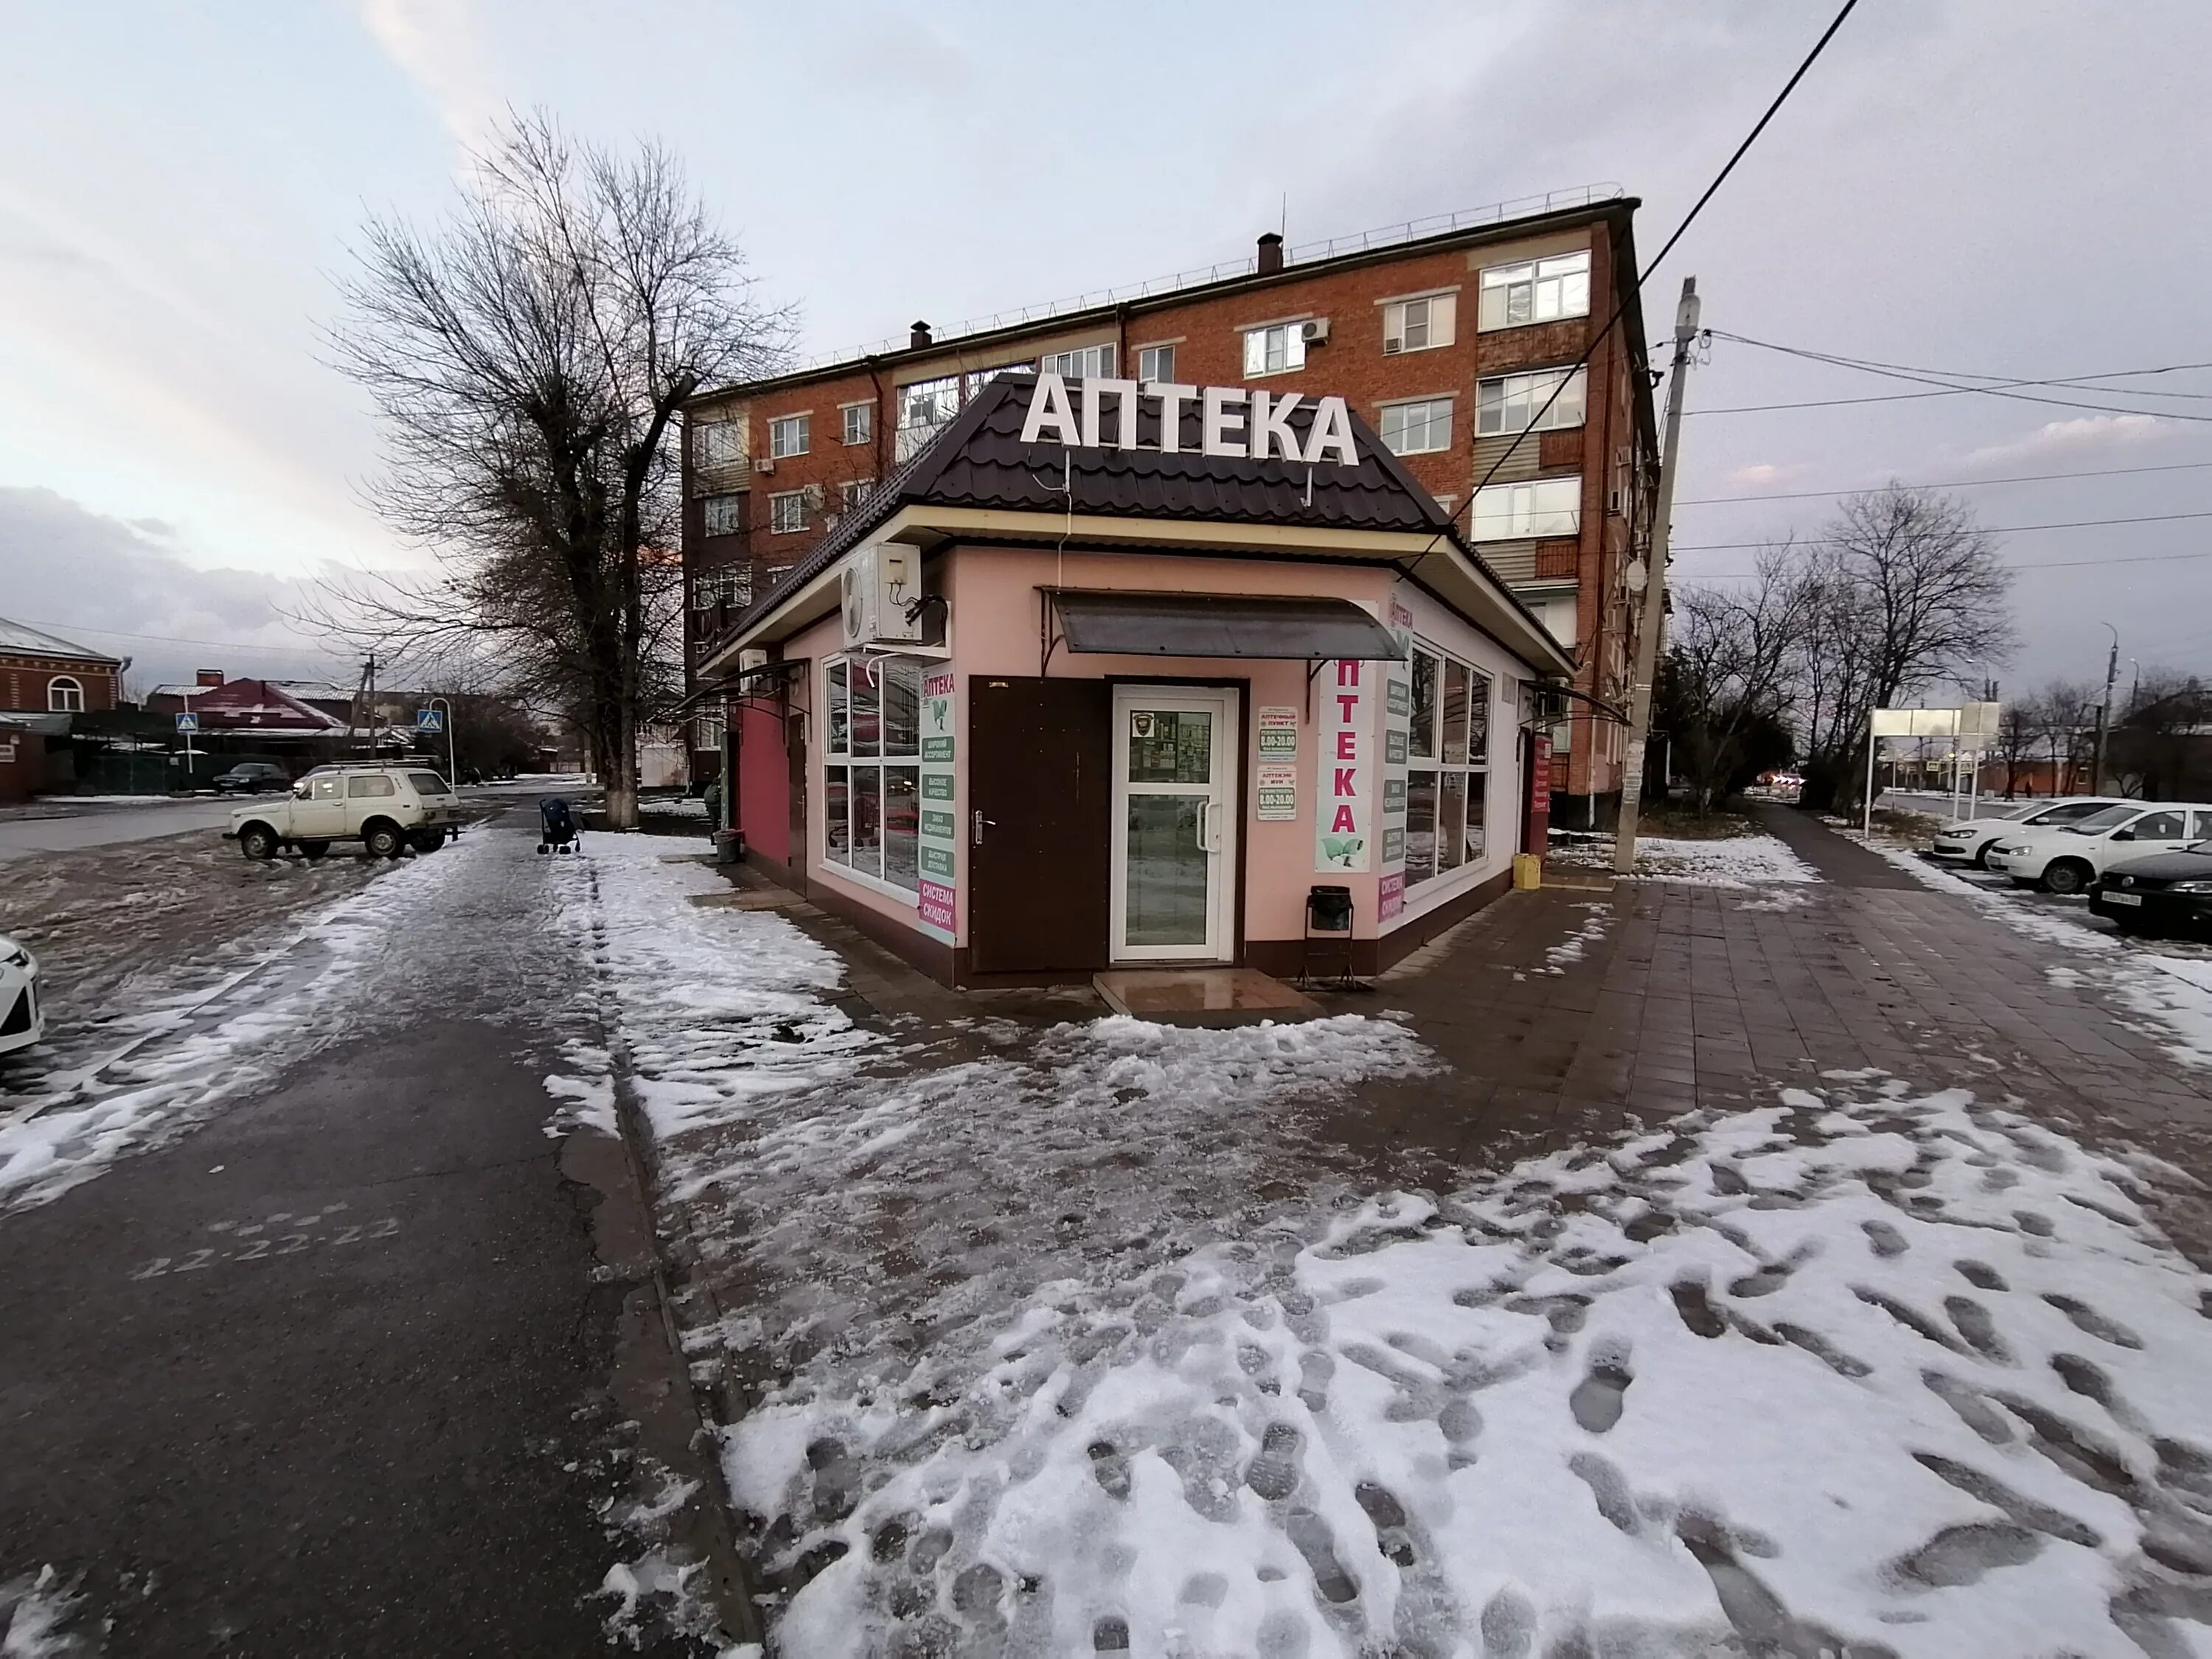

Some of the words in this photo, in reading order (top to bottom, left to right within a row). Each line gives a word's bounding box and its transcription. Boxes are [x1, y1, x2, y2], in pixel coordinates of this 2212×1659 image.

[1020, 372, 1360, 467] АПТЕКА
[923, 673, 955, 698] АПТЕКА
[1261, 736, 1295, 746] 8.00-20.00
[1332, 660, 1360, 832] ПТЕКА
[1259, 794, 1294, 804] 8.00-20.00
[922, 883, 953, 907] СИСТЕМА
[923, 902, 952, 925] СКИДОК
[131, 1217, 399, 1281] 22-22-22
